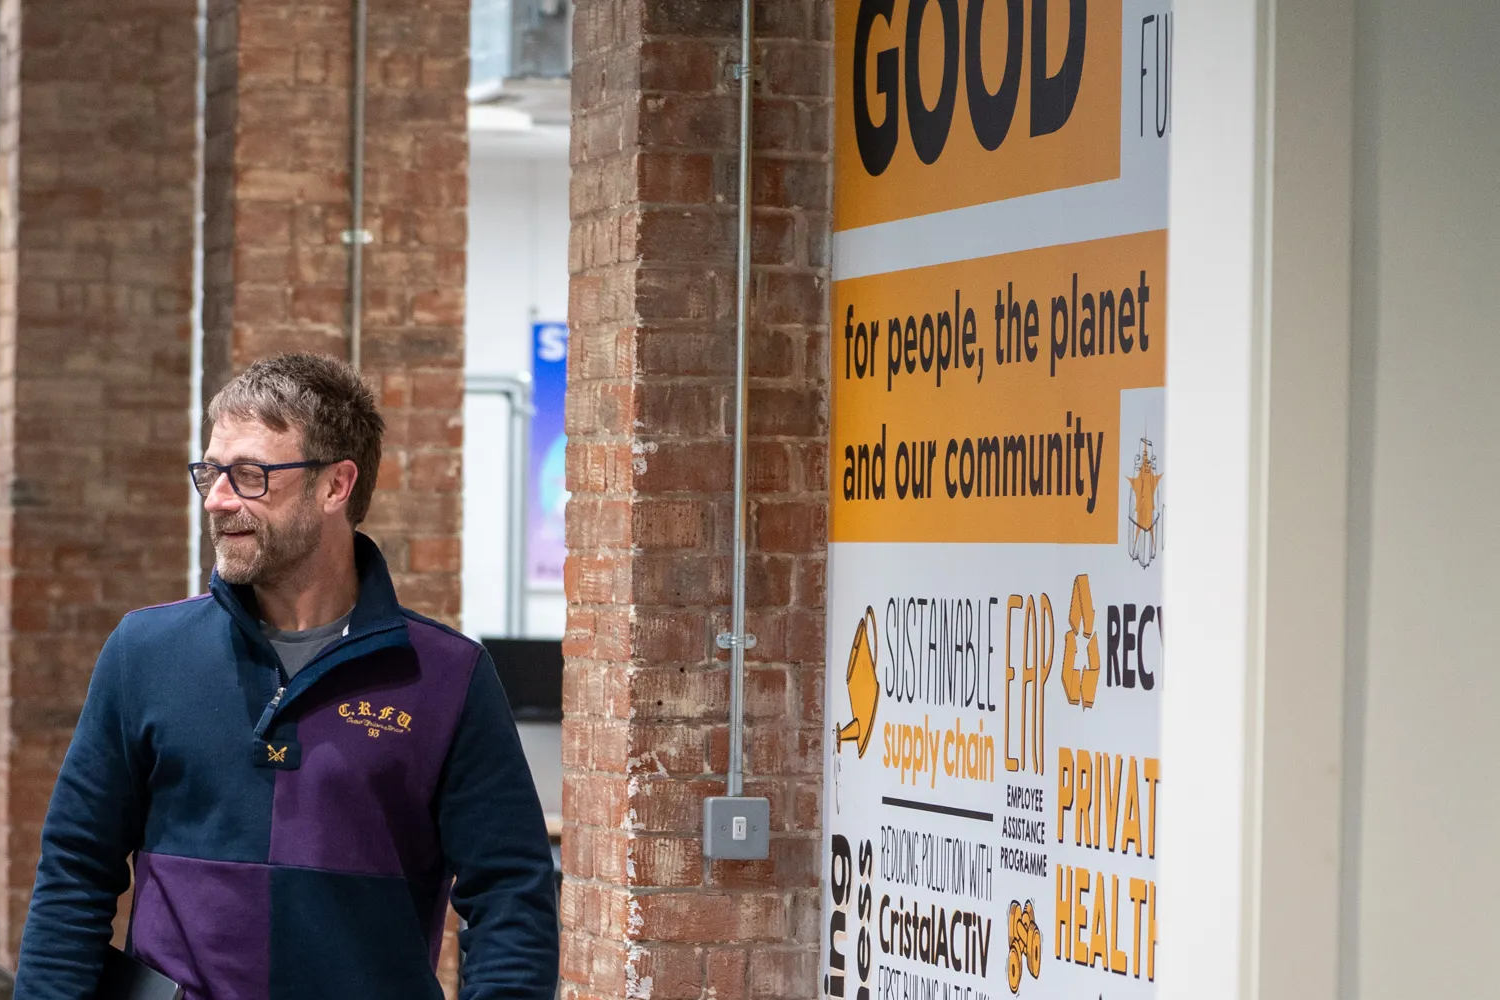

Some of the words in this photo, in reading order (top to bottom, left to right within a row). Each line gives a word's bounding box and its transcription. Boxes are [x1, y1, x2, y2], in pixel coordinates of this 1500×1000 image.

[853, 0, 1087, 177] GOOD
[1140, 11, 1173, 138] FU
[845, 304, 879, 380] for
[888, 289, 984, 392] people,
[995, 281, 1039, 365] the
[1050, 270, 1150, 377] planet
[844, 423, 886, 502] and
[895, 437, 936, 500] our
[945, 411, 1103, 514] community
[885, 596, 998, 712] SUSTAINABLE
[1004, 593, 1054, 776] EAP
[883, 714, 940, 789] supply
[943, 717, 995, 783] chain
[1007, 784, 1043, 813] EMPLOYEE
[1056, 746, 1160, 860] PRIVAT
[881, 825, 919, 887] REDUCING
[921, 833, 966, 896] POLLUTION
[969, 841, 993, 902] WITH
[1000, 846, 1047, 877] PROGRAMME
[1002, 816, 1045, 845] ASSISTANCE
